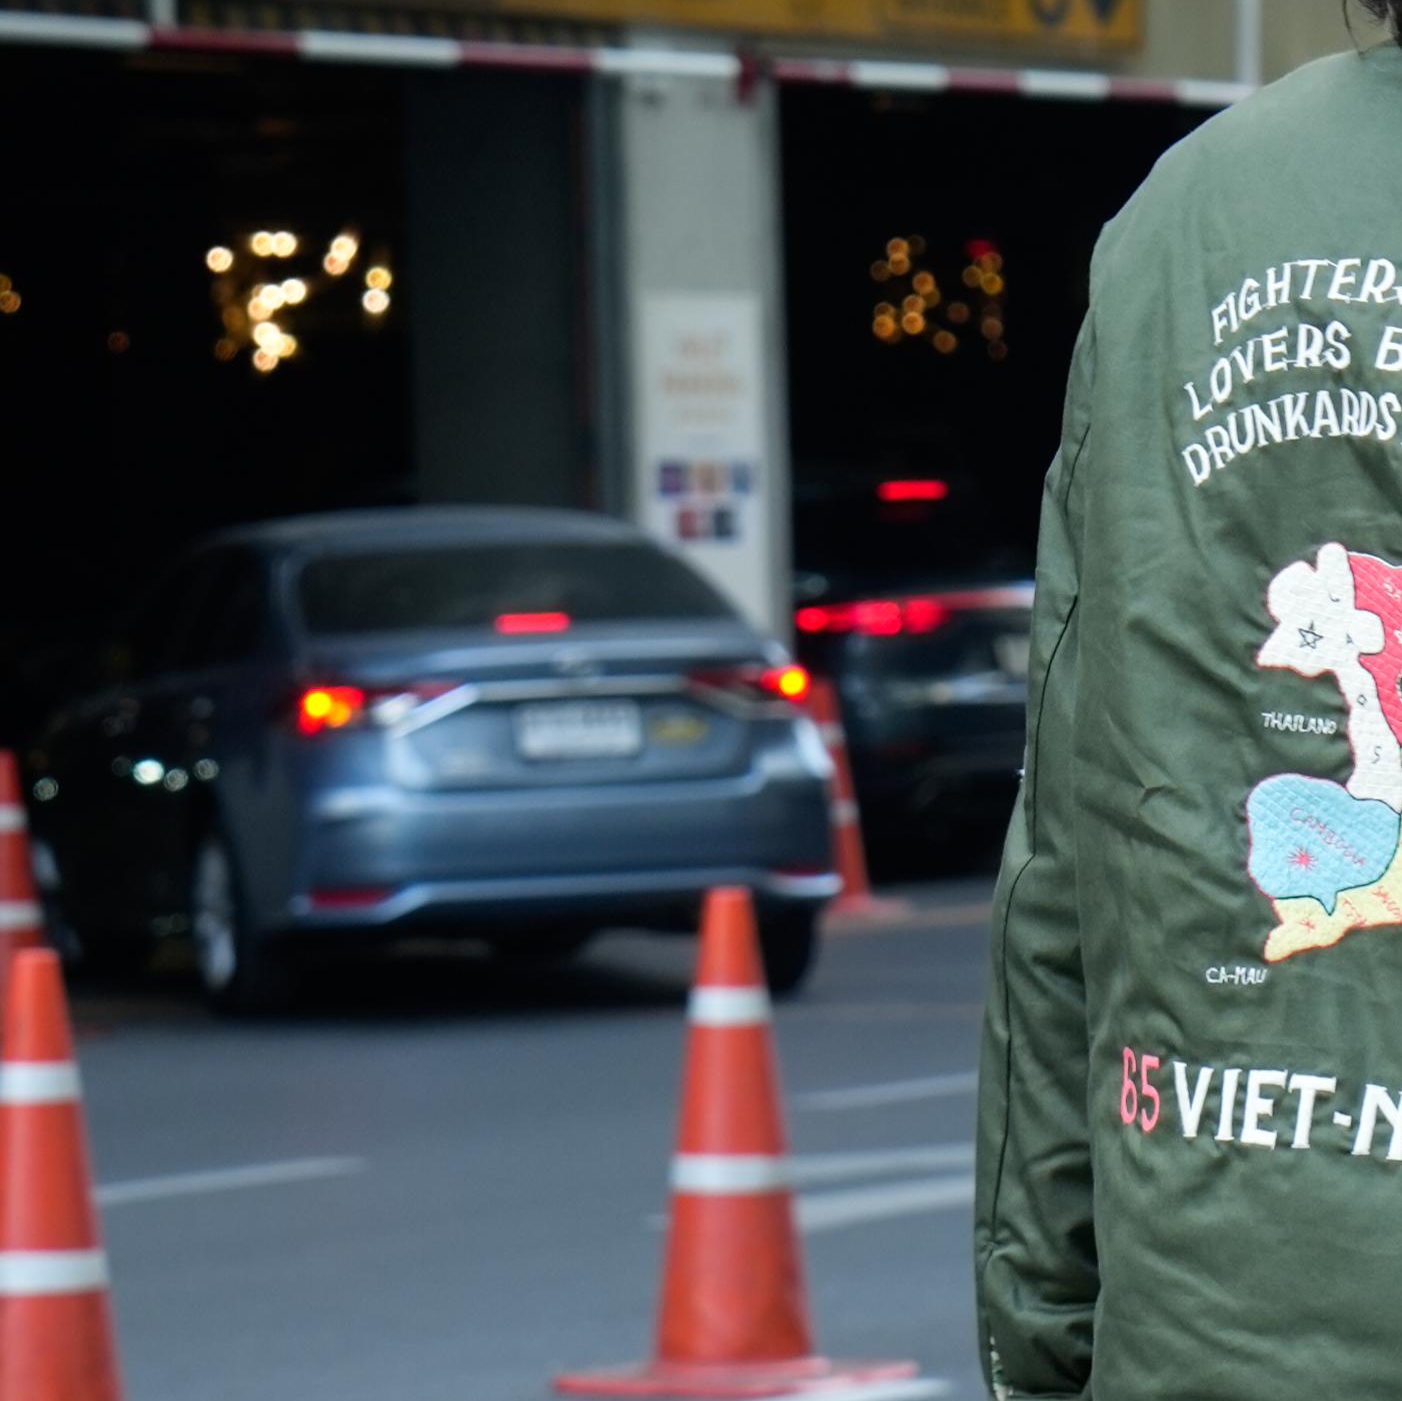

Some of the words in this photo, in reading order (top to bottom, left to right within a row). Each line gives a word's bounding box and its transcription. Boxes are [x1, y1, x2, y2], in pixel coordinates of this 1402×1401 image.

[1184, 320, 1351, 420] LOVERS
[1181, 388, 1402, 487] DRUNKARDS
[1261, 711, 1337, 735] THAILAND
[1205, 965, 1268, 985] CA-MAU
[1119, 1046, 1160, 1134] 65
